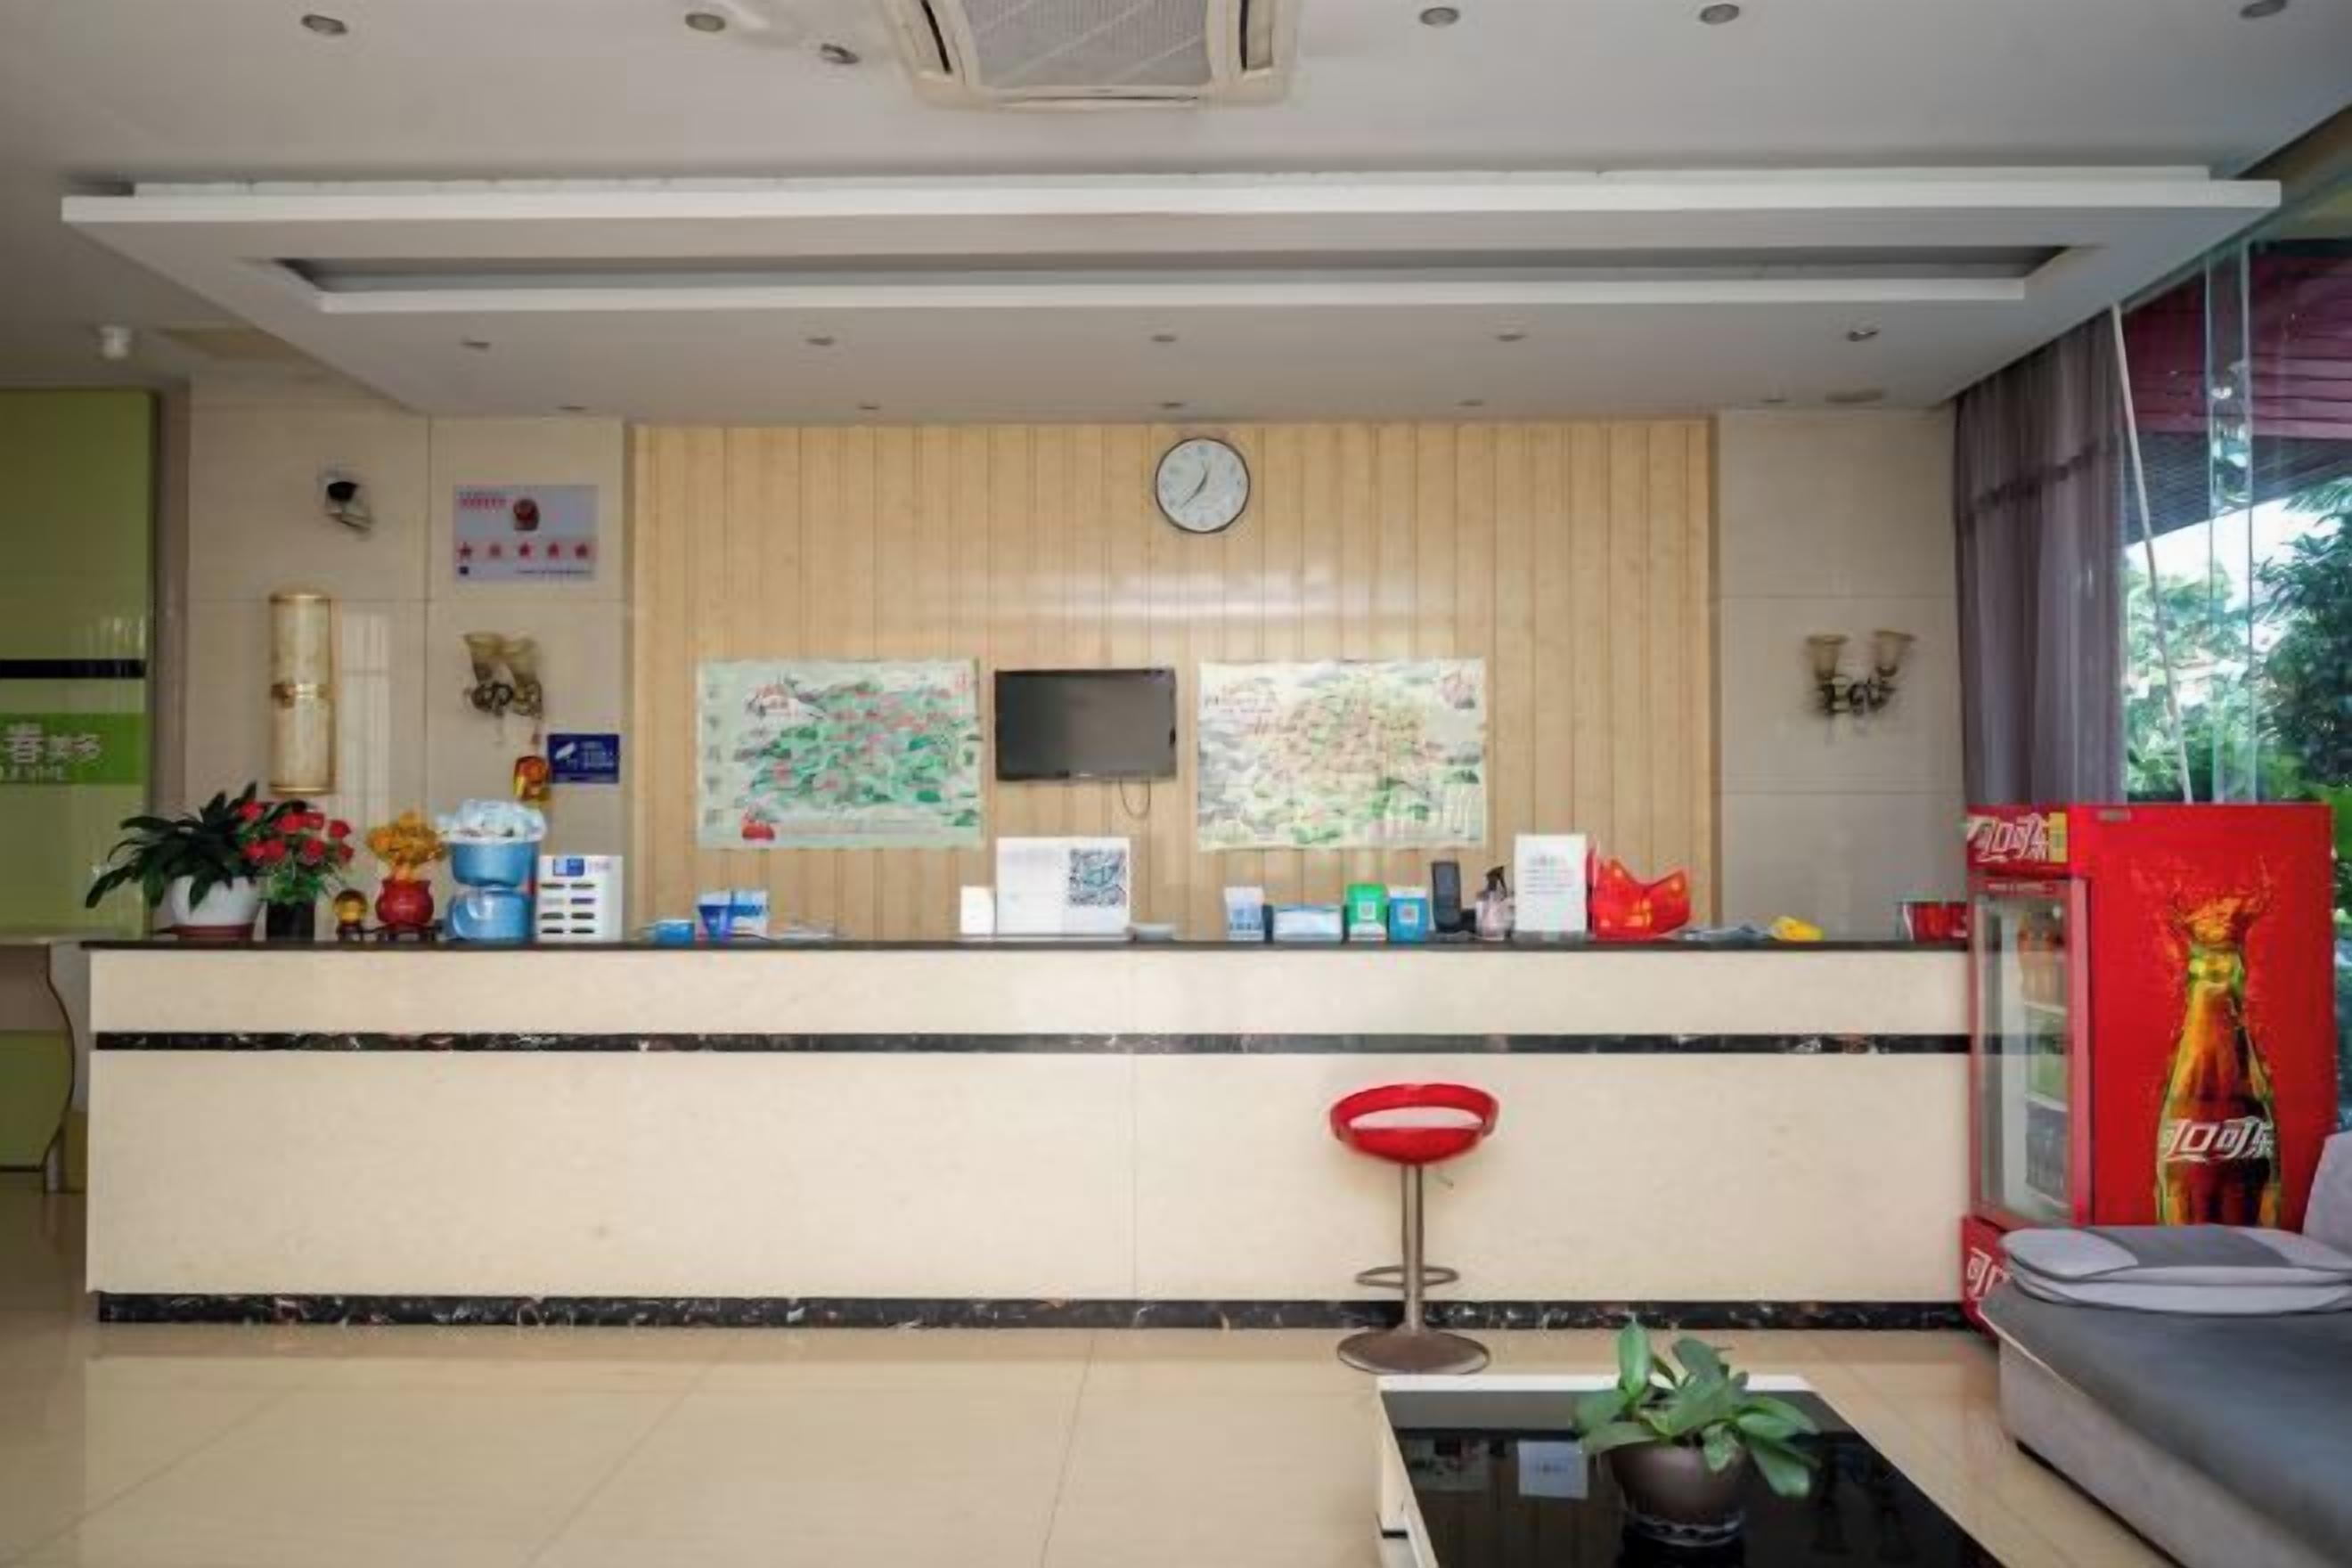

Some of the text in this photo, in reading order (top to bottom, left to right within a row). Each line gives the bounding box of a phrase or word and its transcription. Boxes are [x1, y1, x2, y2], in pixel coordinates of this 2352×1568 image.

[1965, 813, 2050, 862] 可口可乐
[2160, 1116, 2273, 1164] 可口可乐
